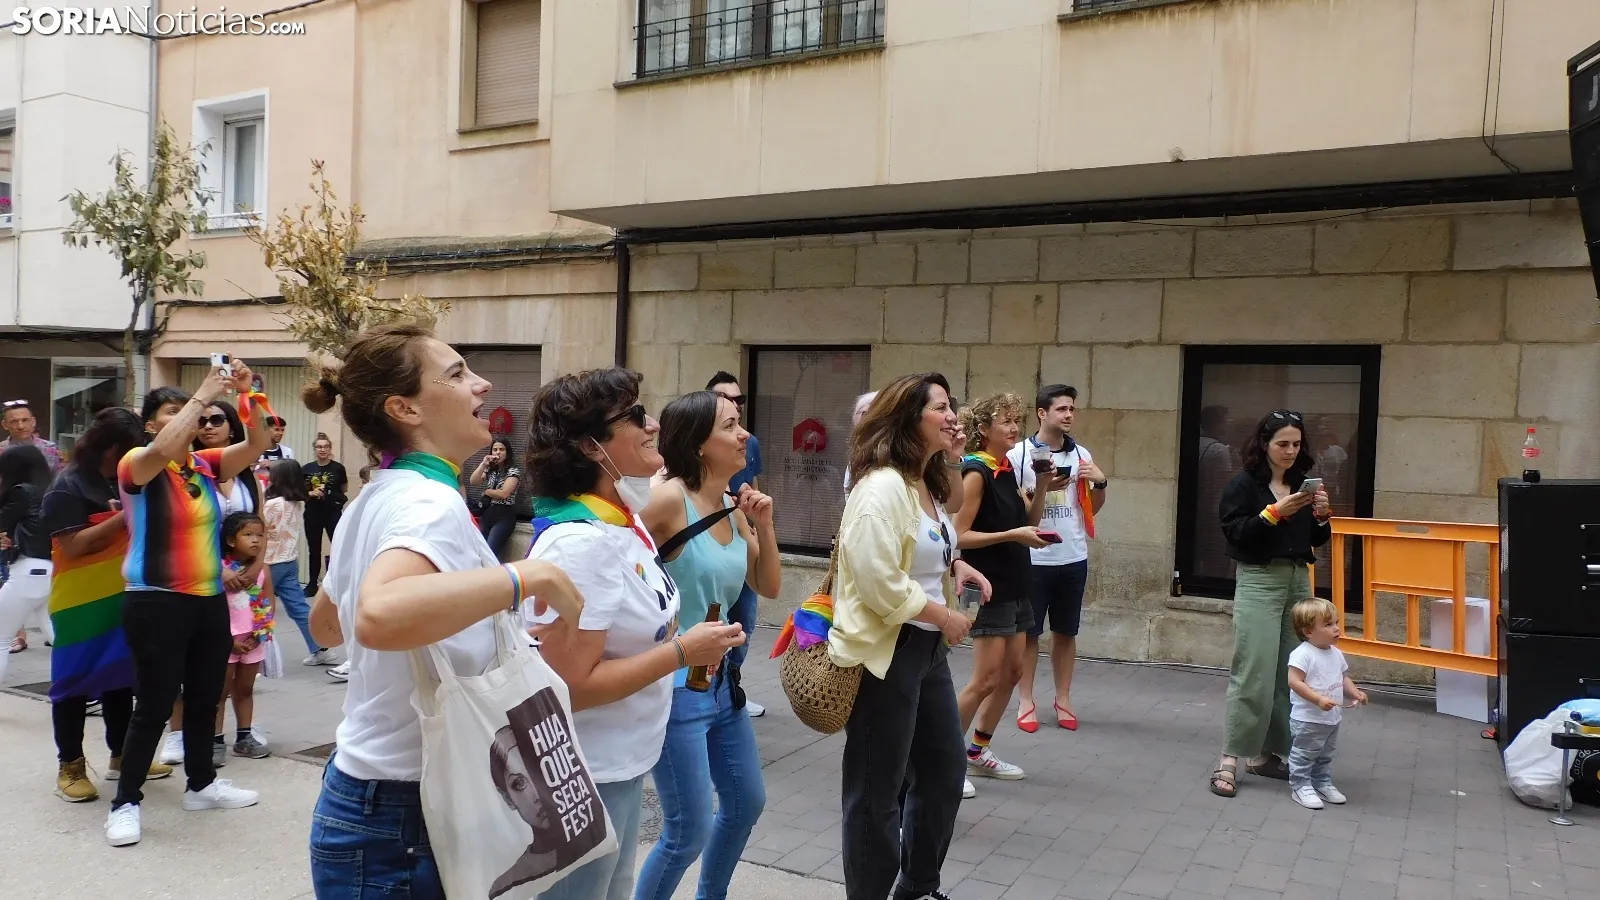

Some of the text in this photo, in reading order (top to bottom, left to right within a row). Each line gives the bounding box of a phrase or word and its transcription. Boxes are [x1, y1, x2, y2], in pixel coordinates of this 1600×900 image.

[528, 712, 568, 757] HIJA
[552, 775, 590, 814] SECA
[561, 797, 594, 843] FEST
